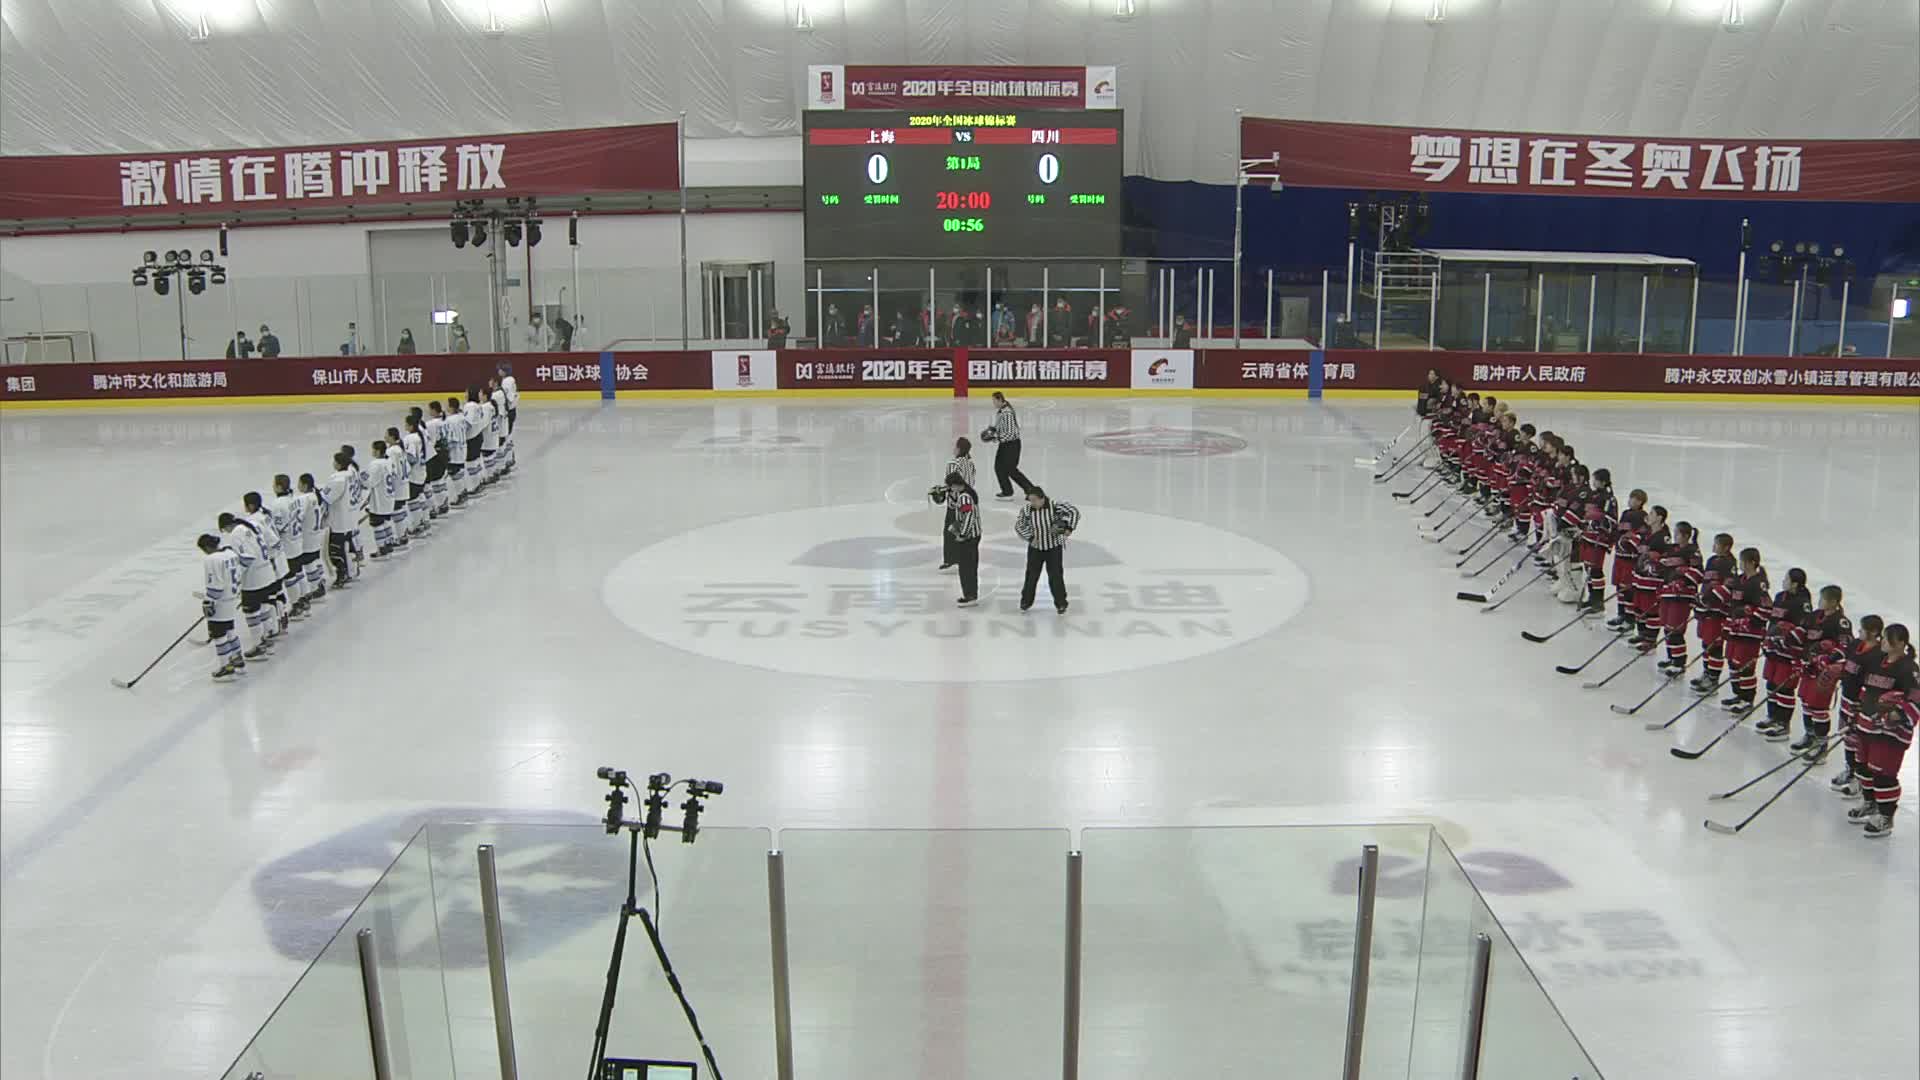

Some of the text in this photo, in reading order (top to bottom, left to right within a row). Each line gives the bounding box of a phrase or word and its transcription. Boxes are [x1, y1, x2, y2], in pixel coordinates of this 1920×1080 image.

[902, 80, 1079, 97] 2020年全国冰球锦标赛
[909, 115, 1016, 126] 2020年全国冰球锦标赛
[866, 129, 895, 144] 上海
[955, 131, 972, 142] VS
[1031, 129, 1060, 144] 四川
[867, 154, 888, 184] 0
[946, 156, 981, 170] 第1局
[1038, 154, 1059, 184] 0
[1410, 134, 1803, 193] 梦想在冬奥飞扬
[119, 143, 507, 206] 激情在腾冲释放
[936, 191, 992, 209] 20:00
[943, 218, 984, 232] 00:56
[93, 372, 228, 390] 腾冲市文化和旅游局
[312, 367, 423, 385] 保山市人民政府
[1473, 364, 1586, 382] 腾冲市人民政府
[6, 376, 36, 392] 集团
